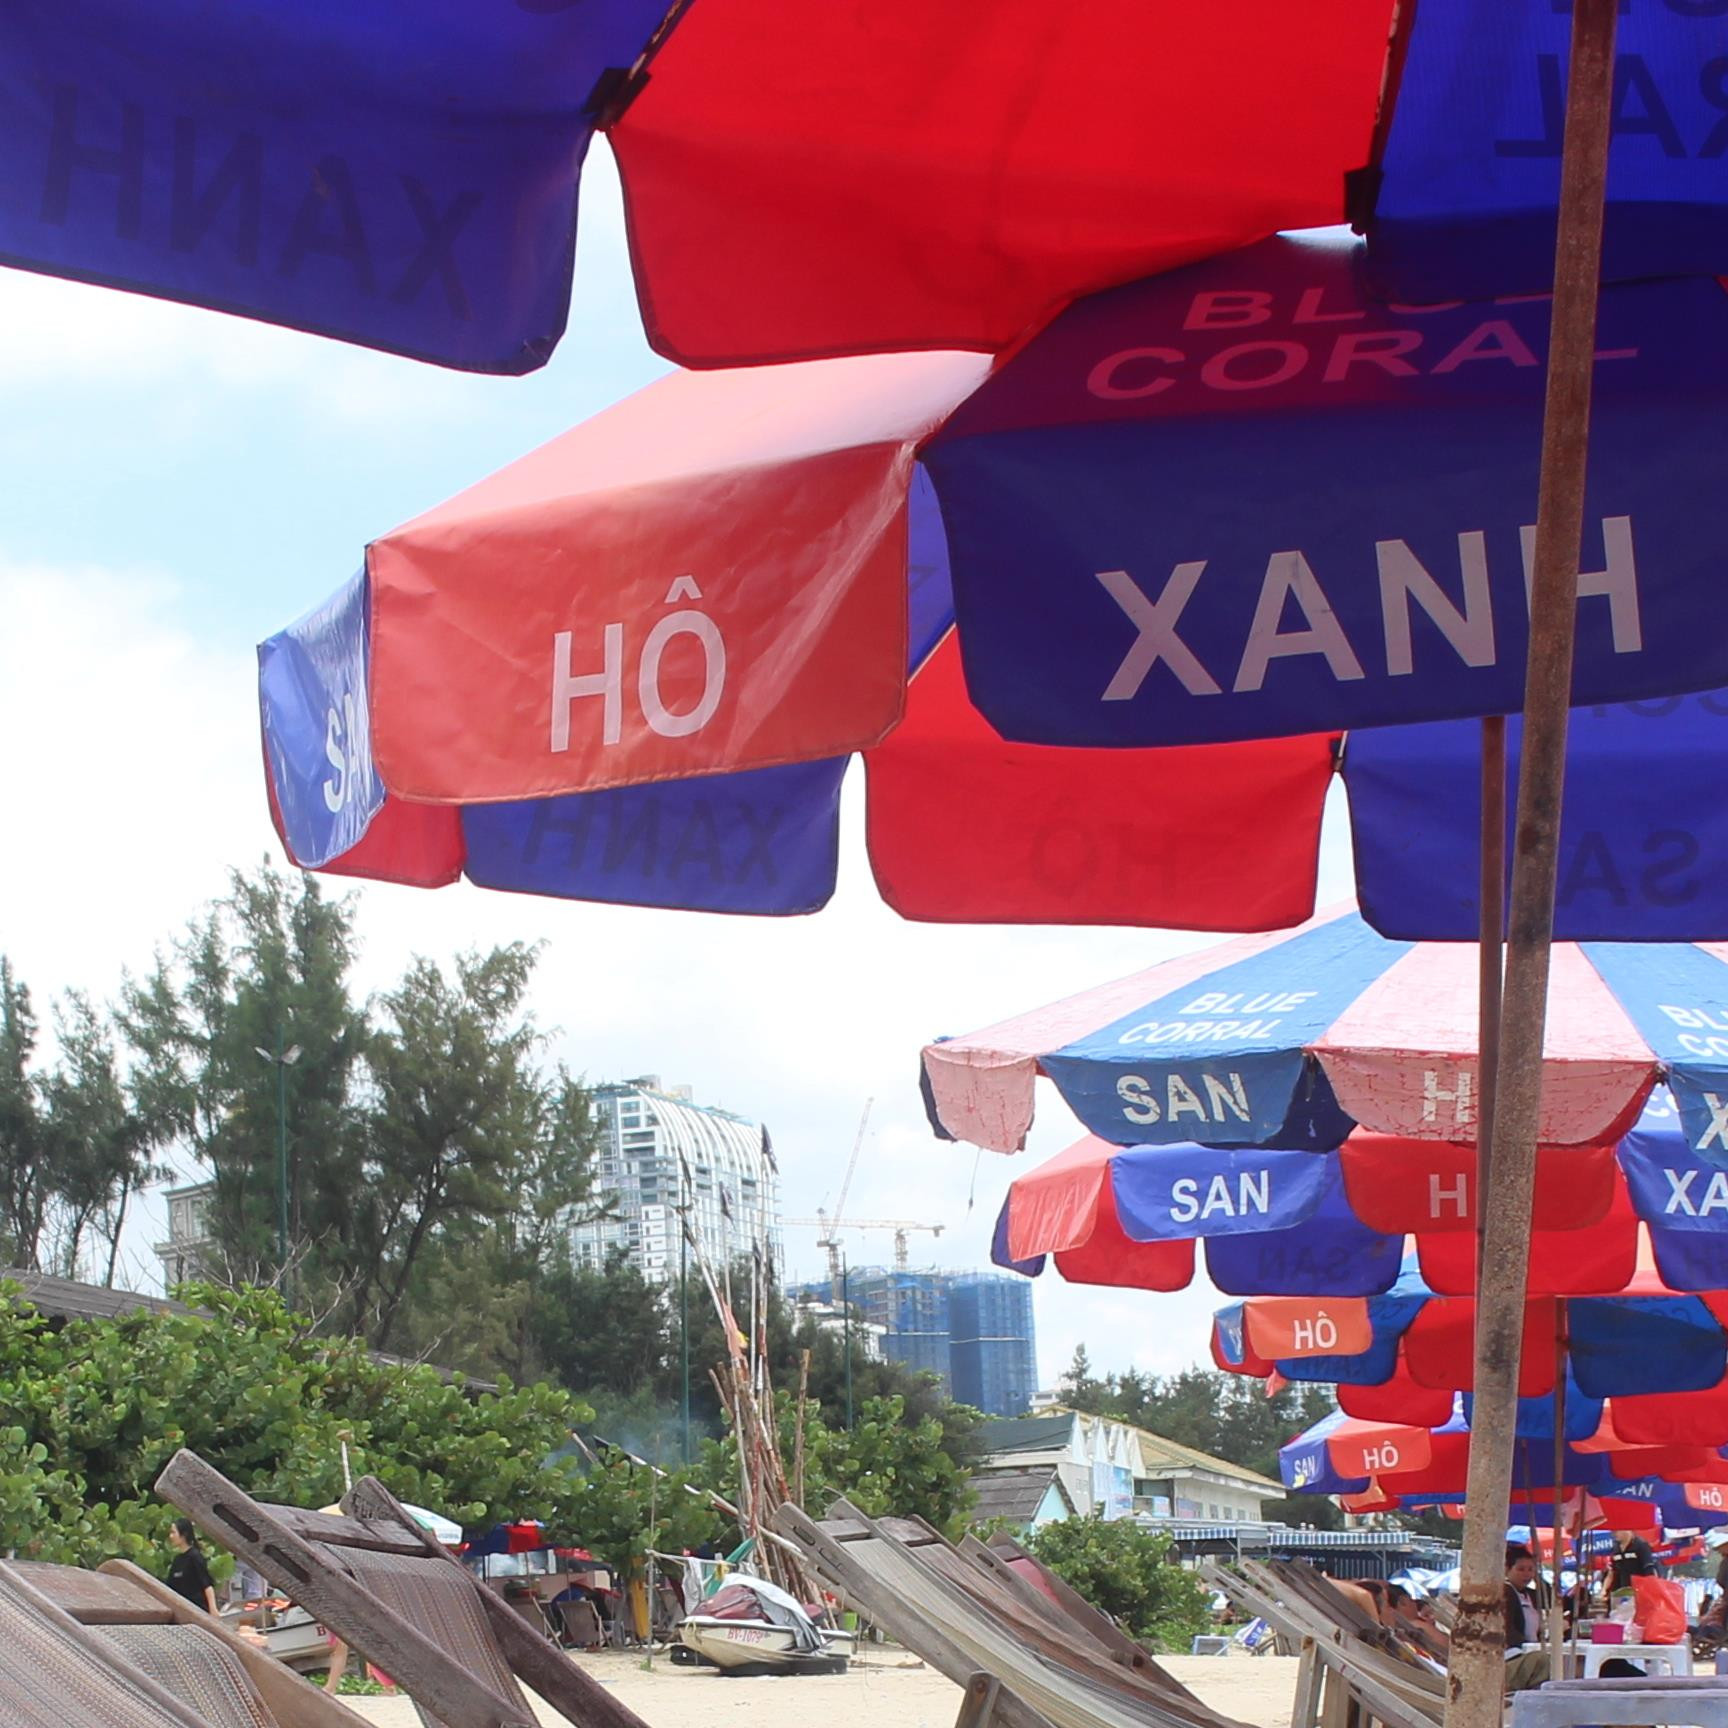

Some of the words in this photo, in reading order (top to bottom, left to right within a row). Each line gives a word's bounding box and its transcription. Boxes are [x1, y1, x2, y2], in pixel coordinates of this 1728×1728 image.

[1093, 516, 1644, 702] XANH
[550, 575, 726, 753] HÔ
[1178, 991, 1316, 1014] BLUE
[1118, 1019, 1278, 1045] CORRAL
[1117, 1072, 1252, 1126] SAN
[1170, 1169, 1270, 1223] SAN
[1294, 1311, 1338, 1350] HÔ
[1363, 1441, 1400, 1470] HÔ
[1699, 1487, 1723, 1507] HÔ
